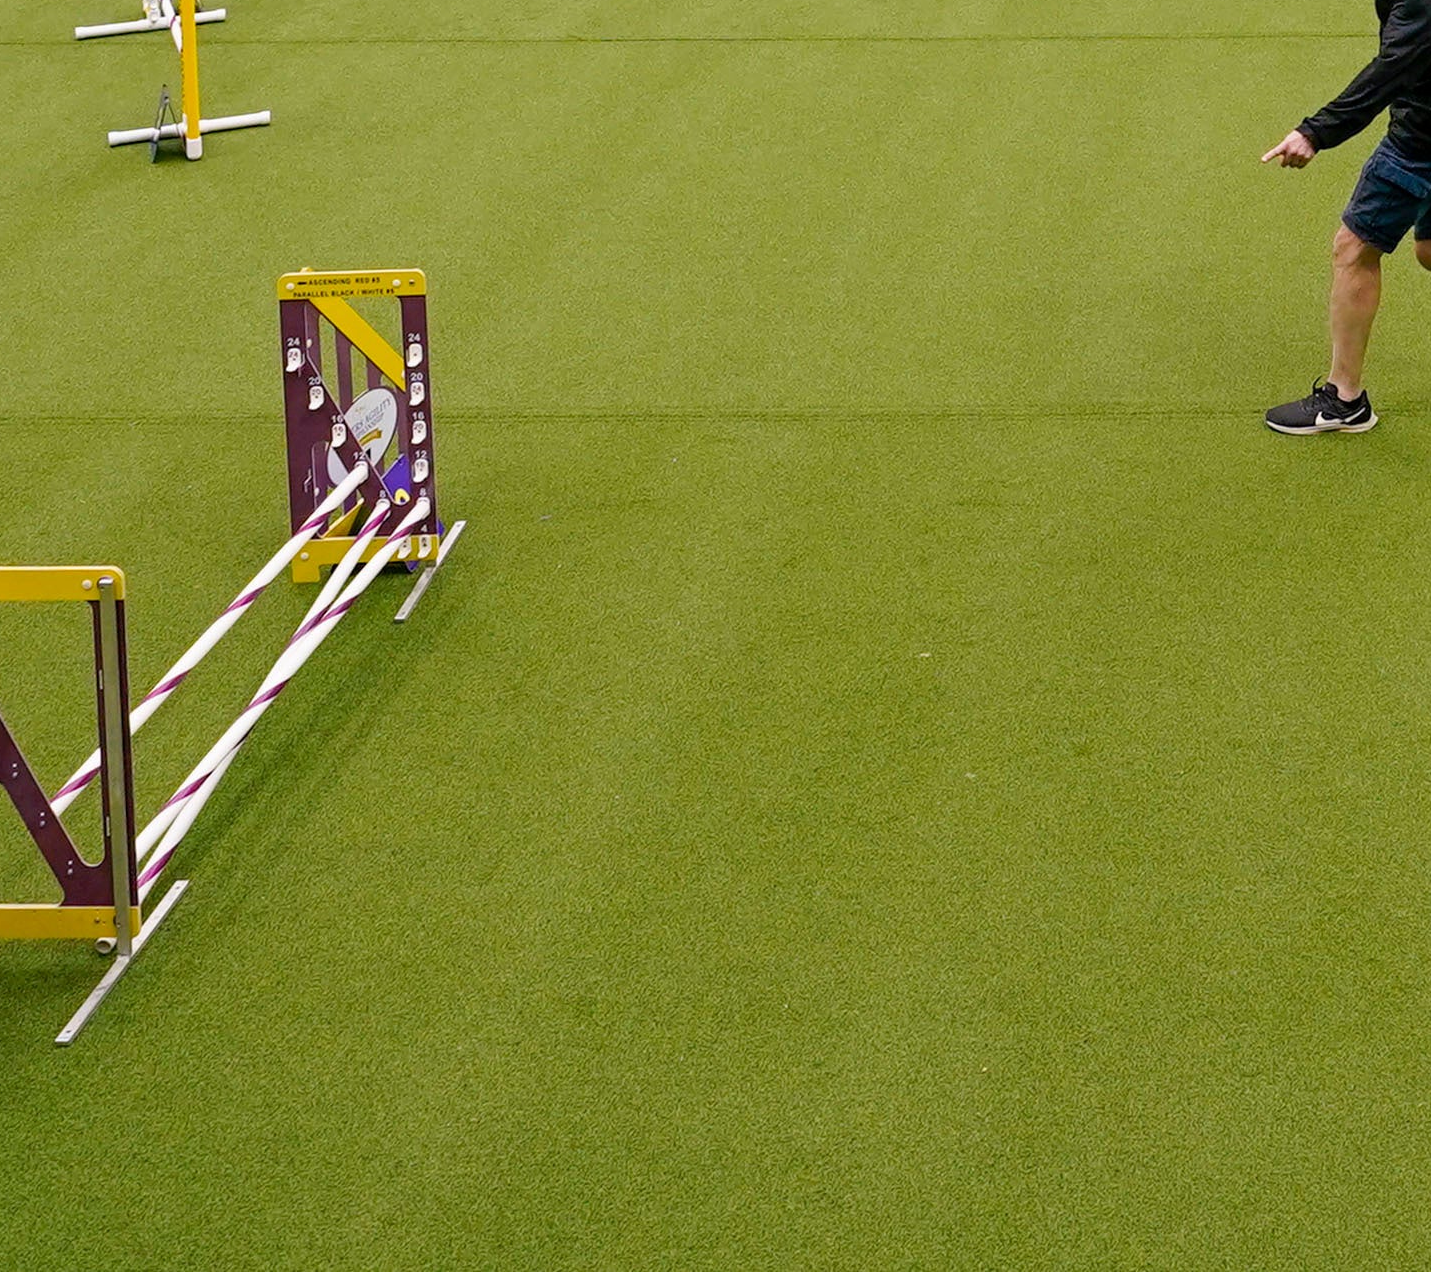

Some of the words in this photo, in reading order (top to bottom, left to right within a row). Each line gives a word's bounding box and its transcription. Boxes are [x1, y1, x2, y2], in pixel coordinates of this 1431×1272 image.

[308, 278, 351, 286] ASCENDING
[362, 288, 384, 296] WHITE
[287, 338, 300, 346] 24
[408, 334, 421, 342] 24
[308, 377, 321, 385] 20
[410, 373, 423, 381] 20
[331, 415, 344, 423] 16
[412, 412, 425, 420] 16
[415, 450, 427, 458] 12
[421, 524, 427, 532] 4
